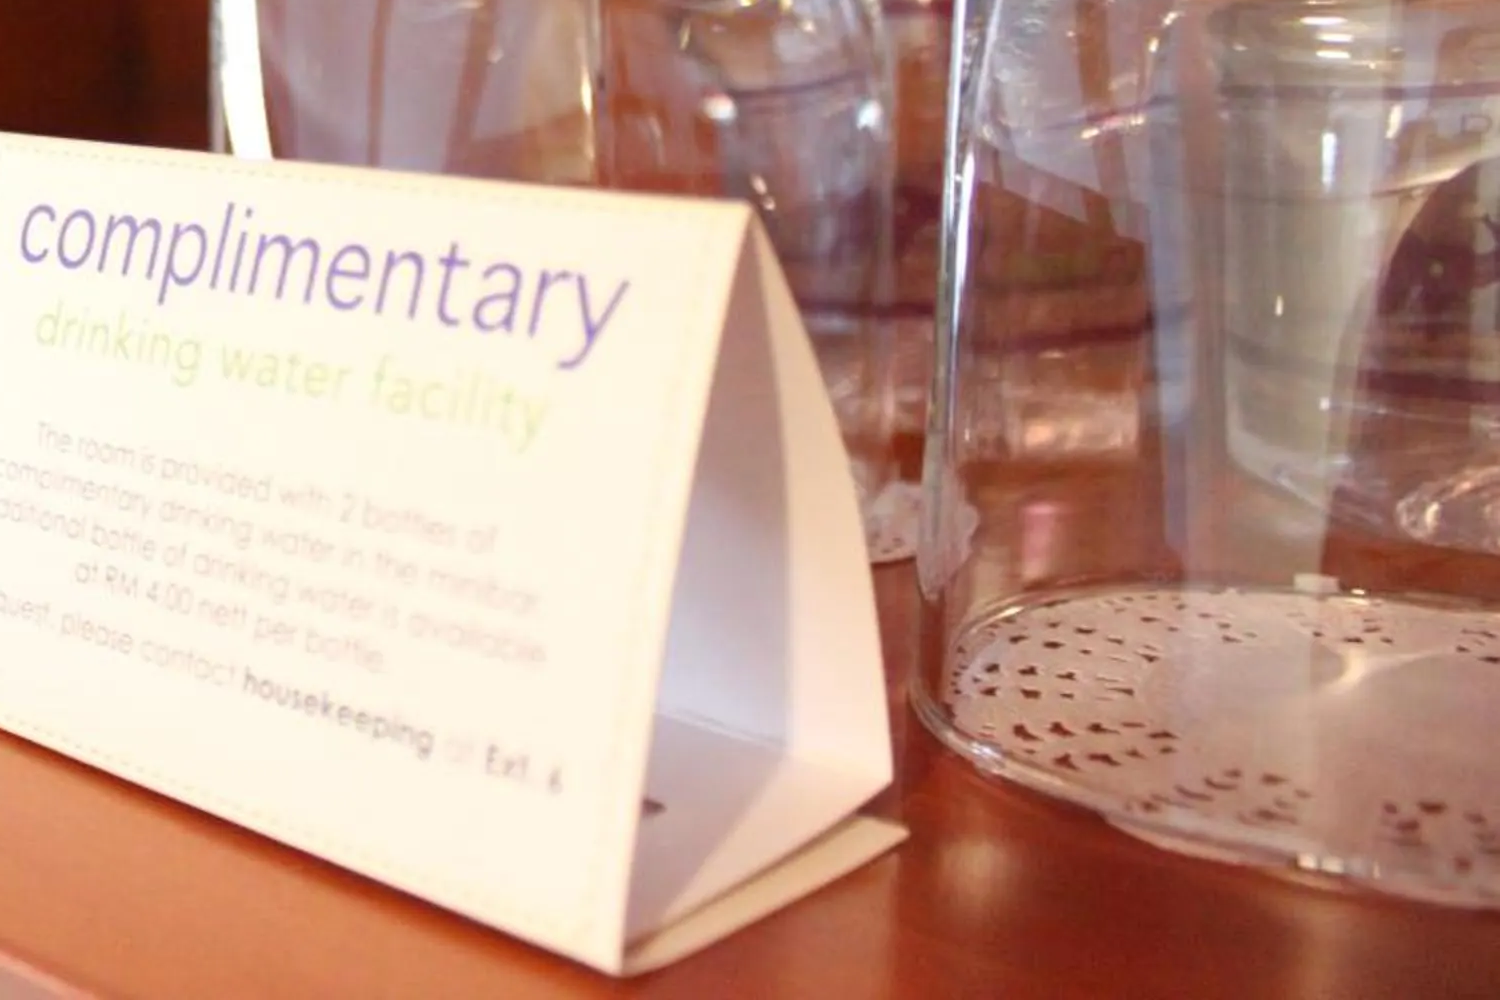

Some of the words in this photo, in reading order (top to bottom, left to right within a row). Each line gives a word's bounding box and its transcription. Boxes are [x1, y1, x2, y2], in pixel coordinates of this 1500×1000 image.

[18, 201, 632, 371] complimentary
[34, 300, 203, 388] drinking
[221, 342, 352, 402] water
[370, 352, 552, 455] facility
[37, 420, 73, 454] The
[78, 436, 136, 467] room
[160, 456, 274, 504] provided
[362, 497, 456, 548] bottles
[157, 497, 254, 551] drinking
[262, 529, 336, 564] water
[90, 518, 156, 562] bottle
[192, 551, 290, 605] drinking
[104, 563, 140, 600] RM
[60, 610, 135, 657] please
[139, 637, 238, 688] contact
[242, 662, 435, 763] housekeeping
